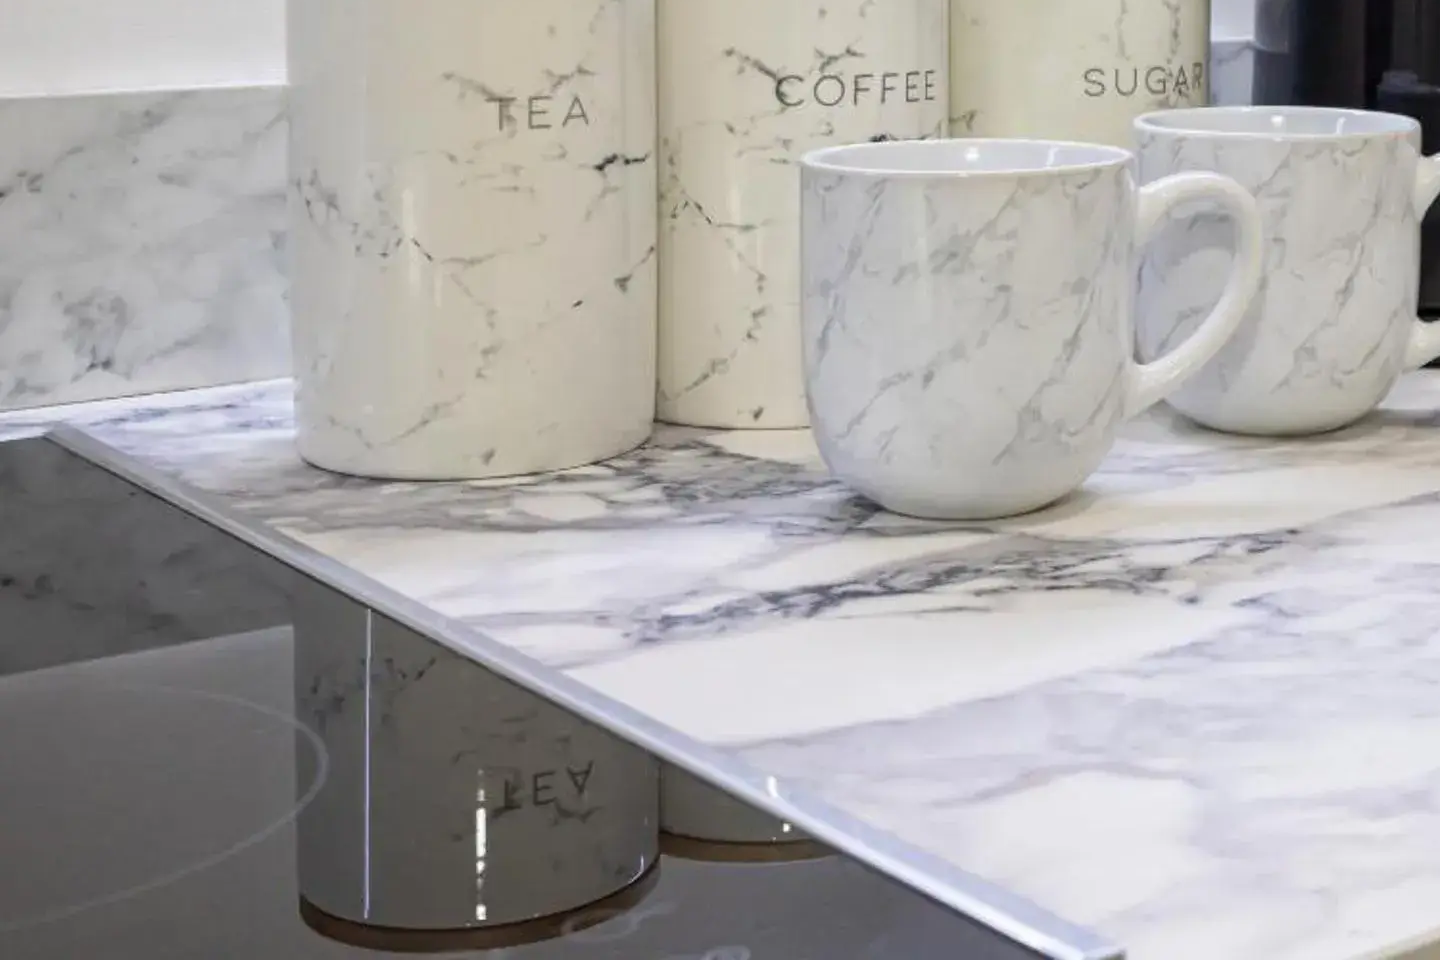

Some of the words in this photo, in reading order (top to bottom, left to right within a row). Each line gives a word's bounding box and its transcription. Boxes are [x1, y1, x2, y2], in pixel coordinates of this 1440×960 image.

[775, 69, 936, 108] COFFEE
[1083, 62, 1204, 97] SUGAR
[484, 95, 589, 132] TEA
